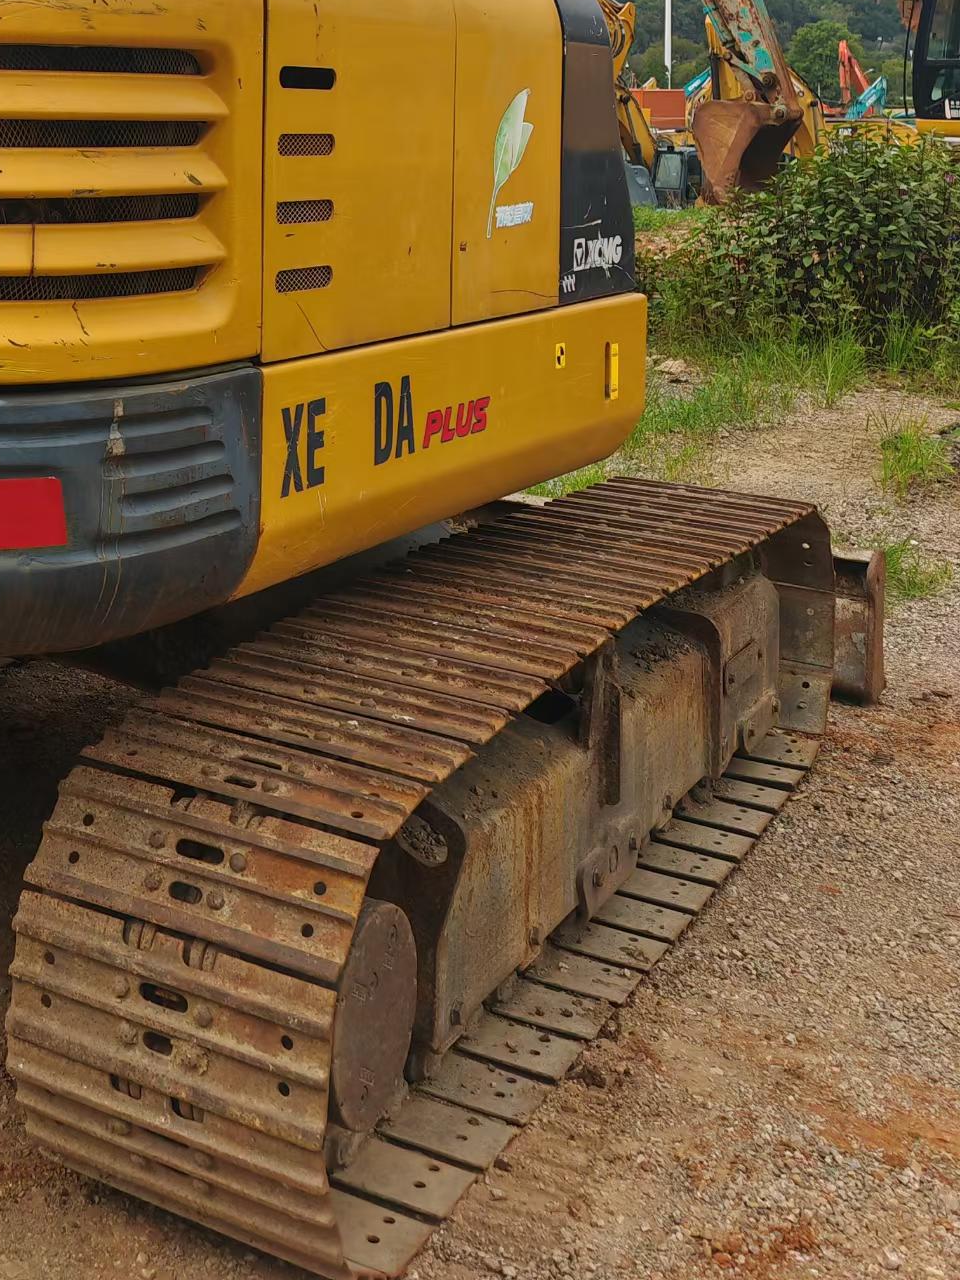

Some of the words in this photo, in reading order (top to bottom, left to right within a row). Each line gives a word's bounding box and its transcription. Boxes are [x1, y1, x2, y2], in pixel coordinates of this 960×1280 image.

[585, 235, 622, 269] XCMG
[280, 397, 326, 498] XE
[374, 375, 415, 465] DA
[422, 396, 490, 449] PLUS
